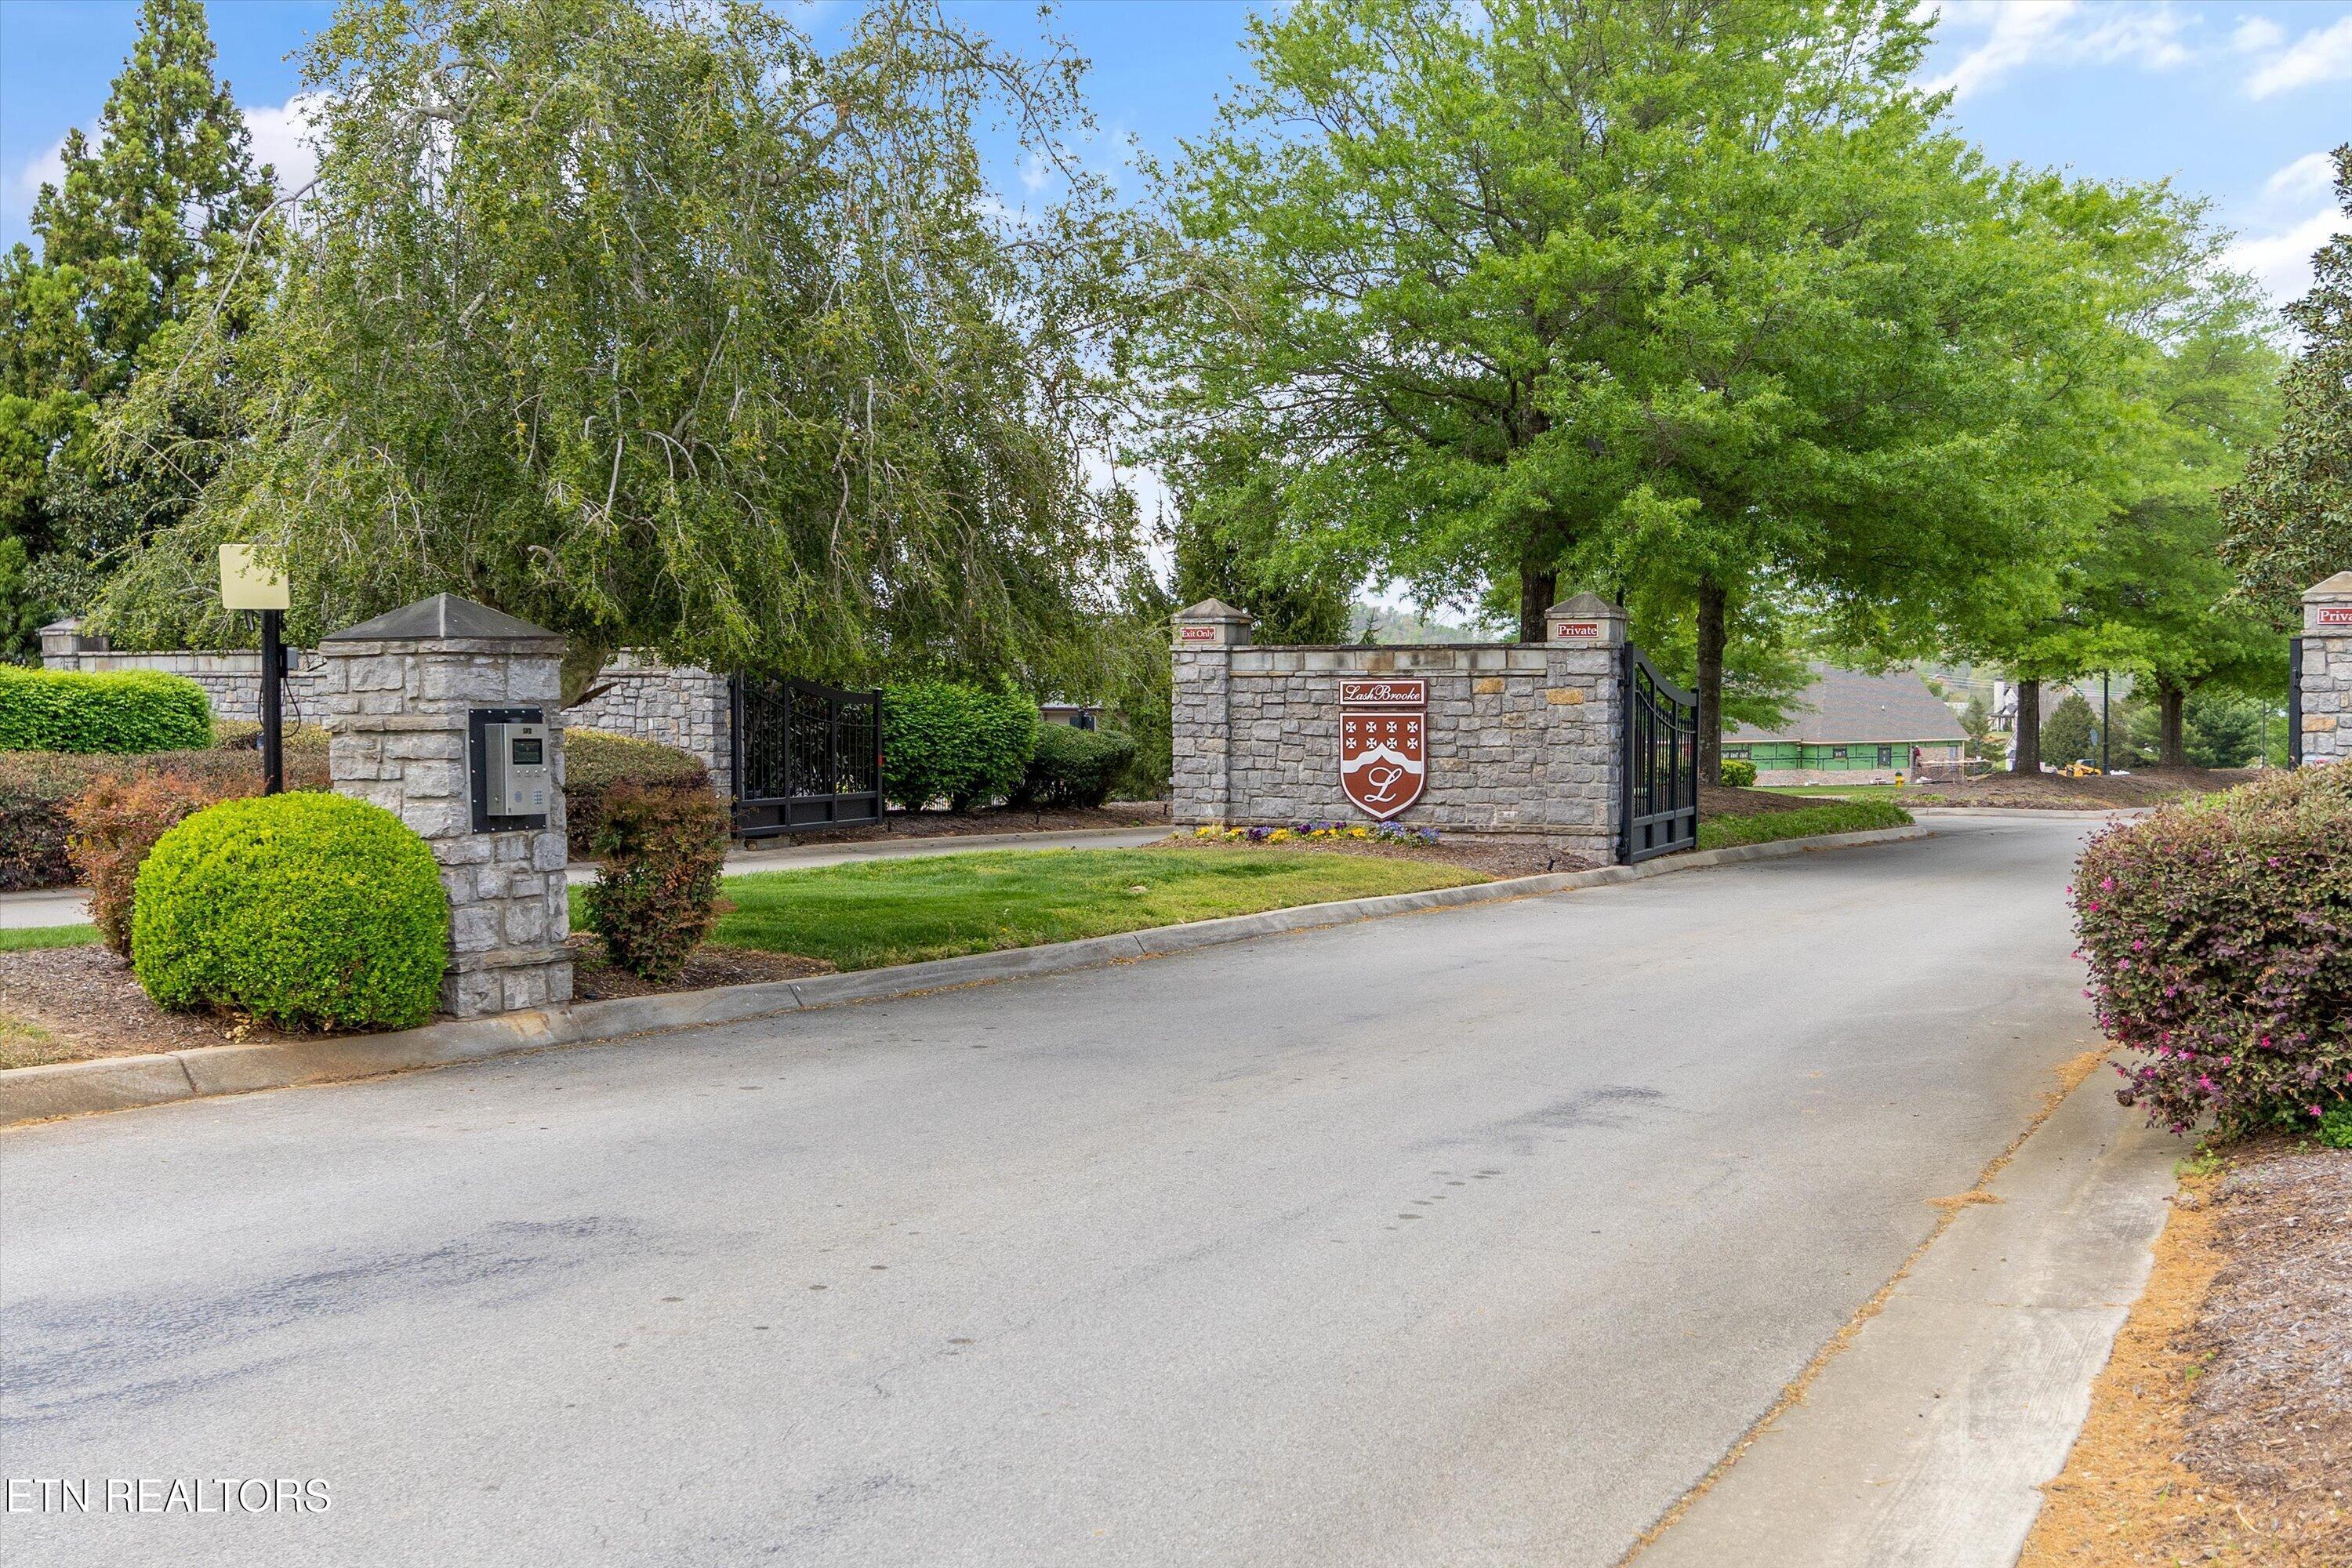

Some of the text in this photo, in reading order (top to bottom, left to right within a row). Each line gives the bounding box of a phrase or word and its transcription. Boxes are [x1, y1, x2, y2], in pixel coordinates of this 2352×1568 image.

[1196, 630, 1214, 640] Only
[1559, 626, 1597, 635] Private
[1344, 684, 1421, 701] LashBrooke
[1364, 767, 1403, 803] L
